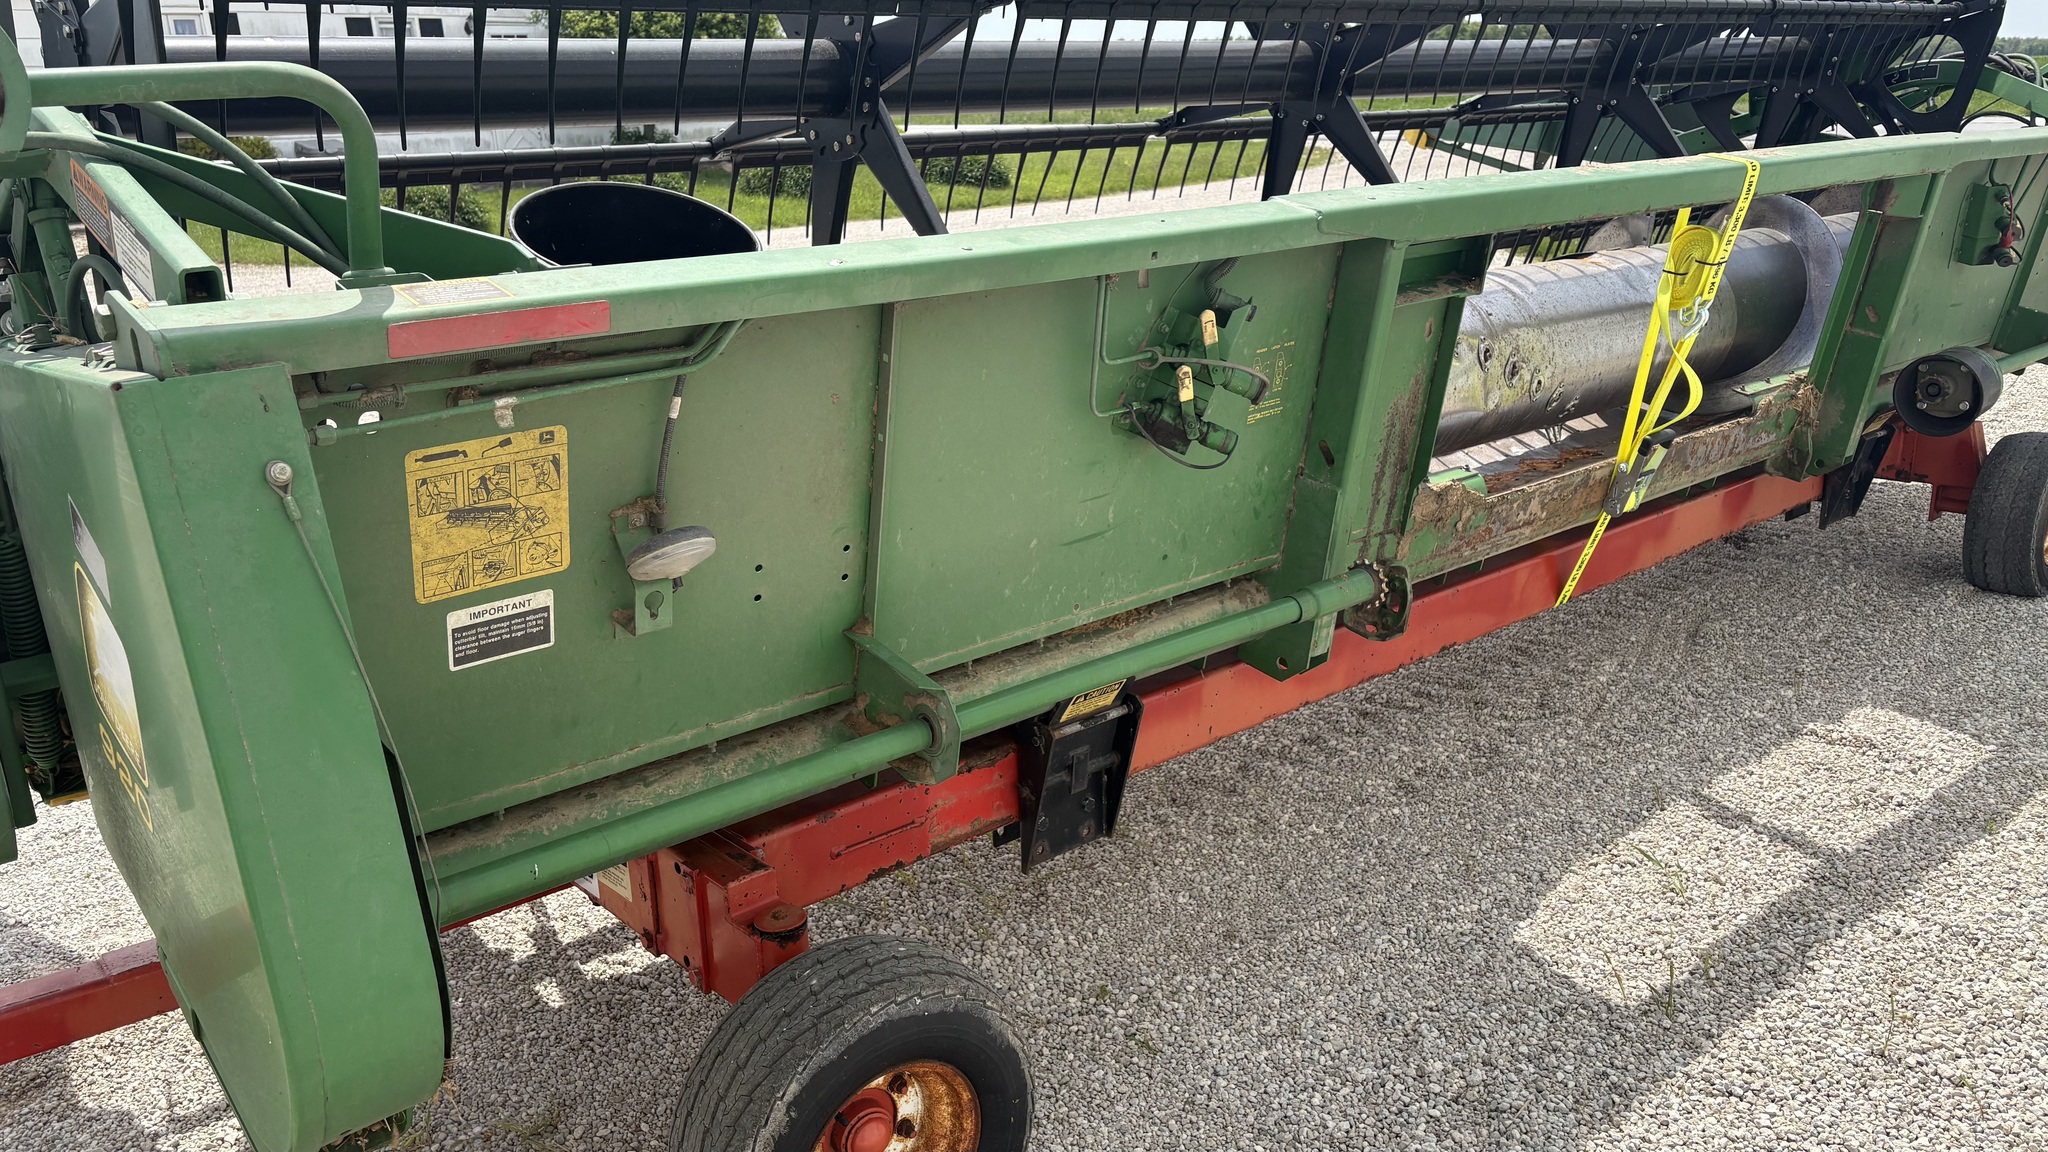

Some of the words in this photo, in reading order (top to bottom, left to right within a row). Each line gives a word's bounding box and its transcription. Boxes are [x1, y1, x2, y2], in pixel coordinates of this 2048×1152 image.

[1742, 174, 1756, 203] LIMIT:
[1731, 206, 1745, 234] 3,300
[1725, 234, 1735, 247] LB
[1707, 281, 1716, 295] KG
[469, 599, 533, 620] IMPORTANT
[462, 628, 477, 637] avoid
[490, 620, 510, 630] damage
[526, 611, 548, 621] adjusting
[454, 635, 478, 645] cutterbar
[488, 626, 510, 637] maintain
[454, 641, 479, 652] clearance
[480, 635, 502, 646] between
[511, 629, 526, 637] auger
[526, 625, 544, 634] fingers
[455, 650, 465, 658] and
[465, 648, 480, 656] floor.
[1086, 682, 1121, 700] CAUTION
[99, 722, 154, 833] 920
